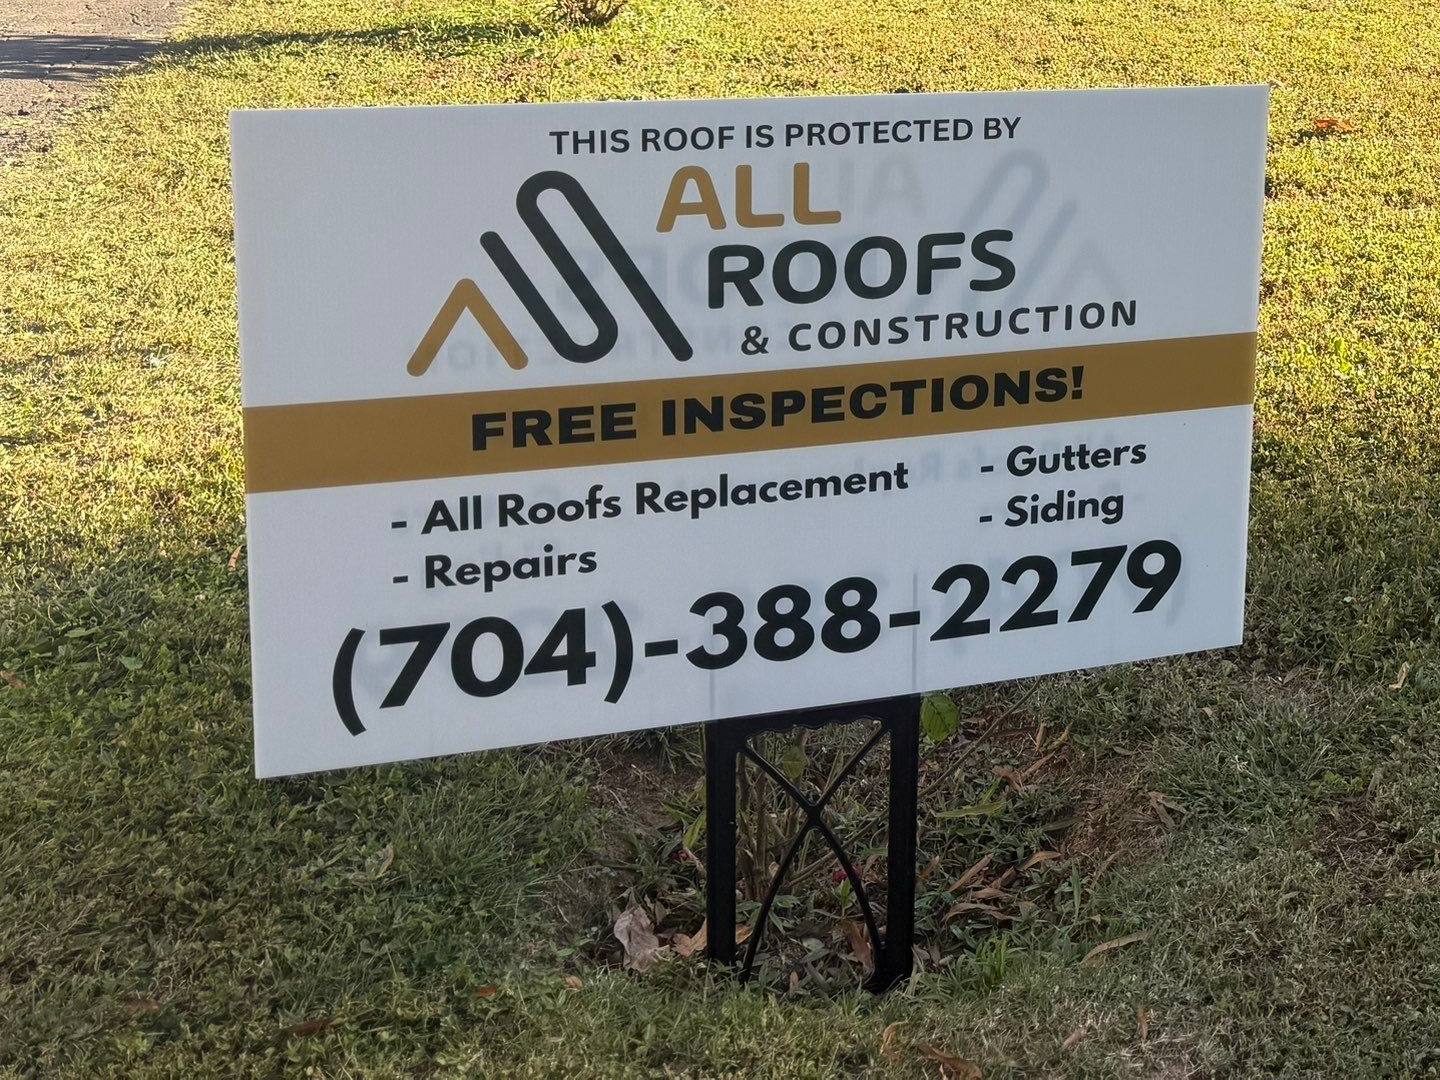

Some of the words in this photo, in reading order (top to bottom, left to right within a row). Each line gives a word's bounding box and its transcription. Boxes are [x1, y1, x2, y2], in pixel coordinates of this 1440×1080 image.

[549, 129, 630, 155] THIS
[641, 126, 735, 152] ROOF
[746, 124, 774, 149] IS
[785, 118, 973, 147] PROTECTED
[983, 116, 1022, 140] BY
[656, 161, 842, 232] ALL
[707, 229, 1017, 309] ROOFS
[740, 325, 769, 356] &
[787, 300, 1137, 352] CONSTRUCTION
[470, 402, 637, 452] FREE
[660, 365, 1086, 437] INSPECTIONS!
[1006, 443, 1148, 477] Gutters
[421, 495, 483, 535] All
[498, 484, 623, 528] Roofs
[635, 462, 910, 520] Replacement
[1004, 488, 1125, 527] Siding
[424, 543, 598, 593] Repairs
[331, 538, 1183, 737] (704)-388-2279
